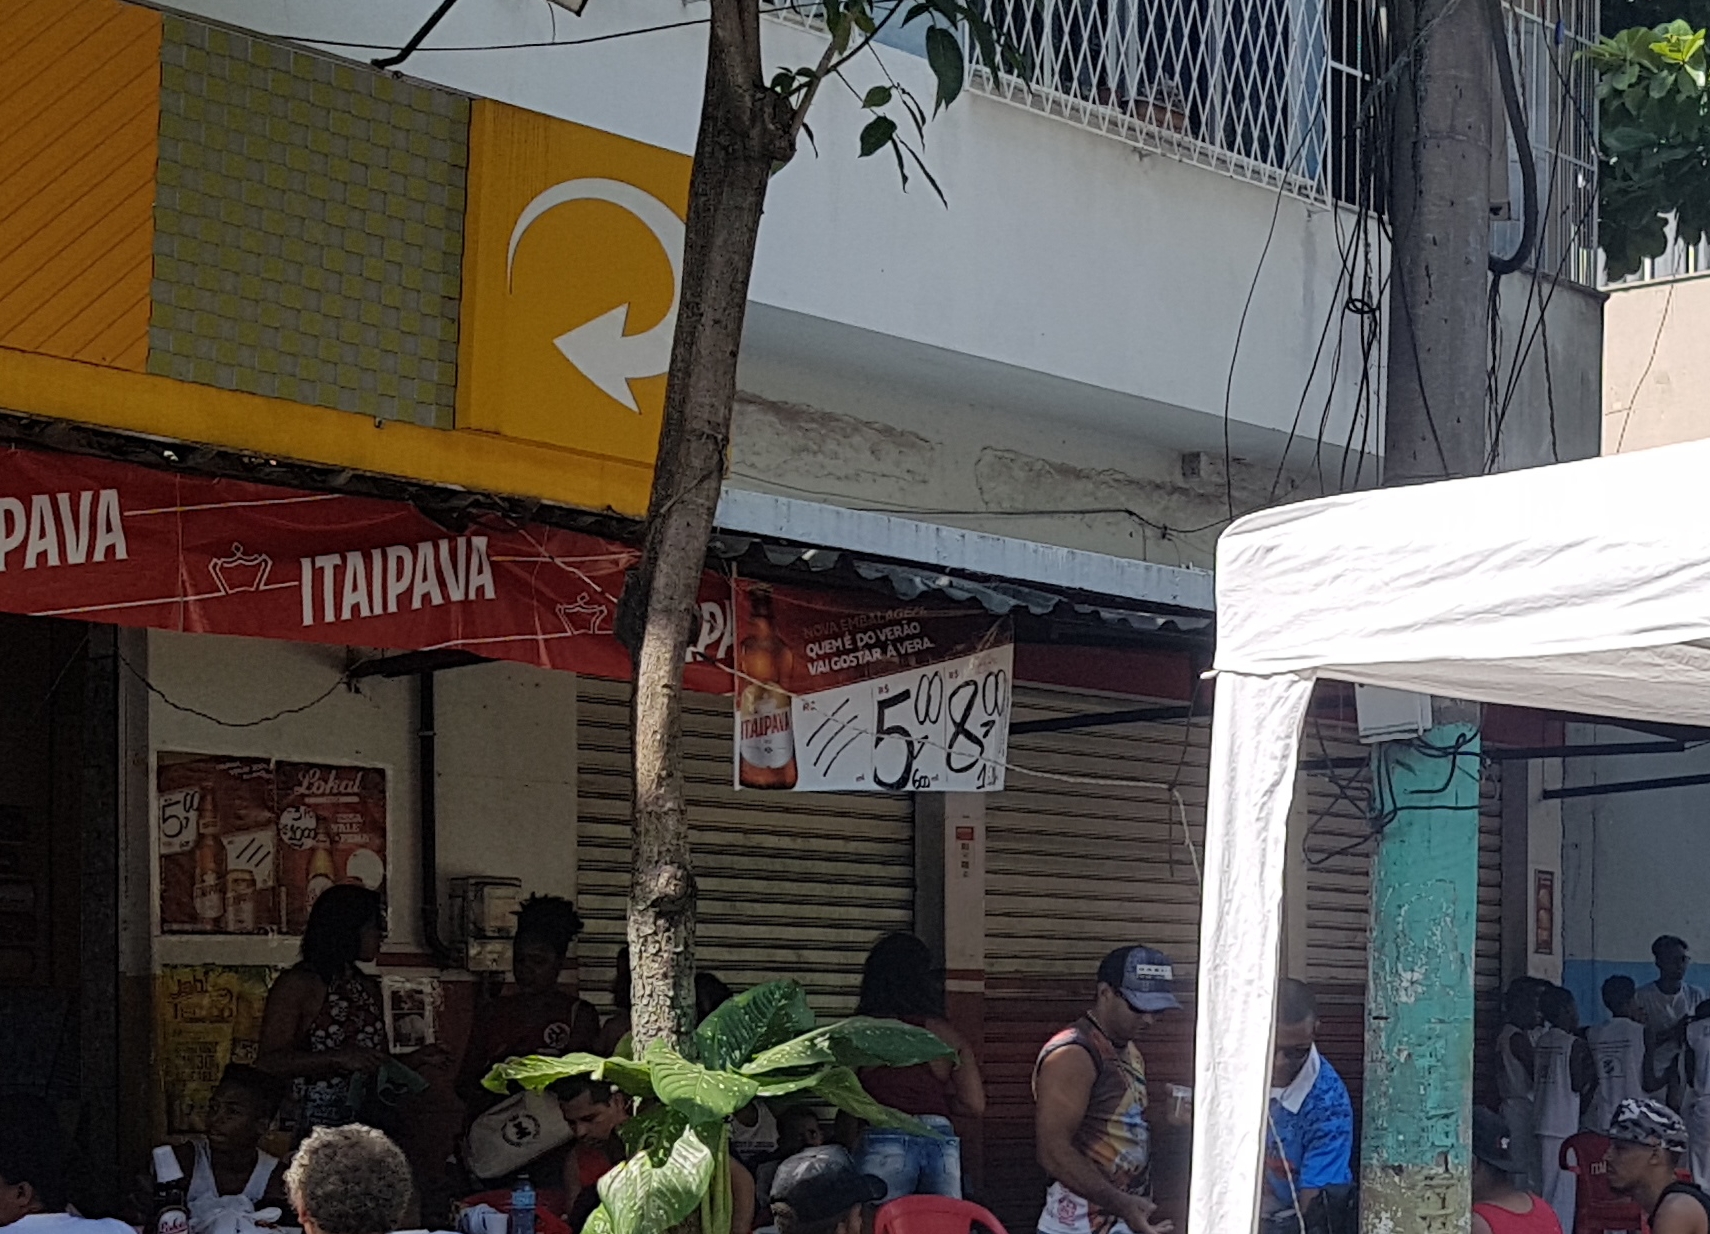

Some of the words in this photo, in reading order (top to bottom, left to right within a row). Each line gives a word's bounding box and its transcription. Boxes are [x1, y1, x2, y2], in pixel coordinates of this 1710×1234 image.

[0, 488, 129, 571] PAVA
[300, 536, 496, 626] ITAIPAVA
[803, 621, 838, 638] NOVA
[806, 639, 843, 658] QUEM
[843, 631, 854, 649] É
[856, 632, 877, 648] DO
[877, 620, 921, 642] VERÃO
[806, 658, 831, 676] VAI
[830, 649, 882, 670] GOSTAR
[886, 641, 898, 658] À
[741, 711, 790, 740] ITAIPAVA
[294, 767, 364, 795] Lokal
